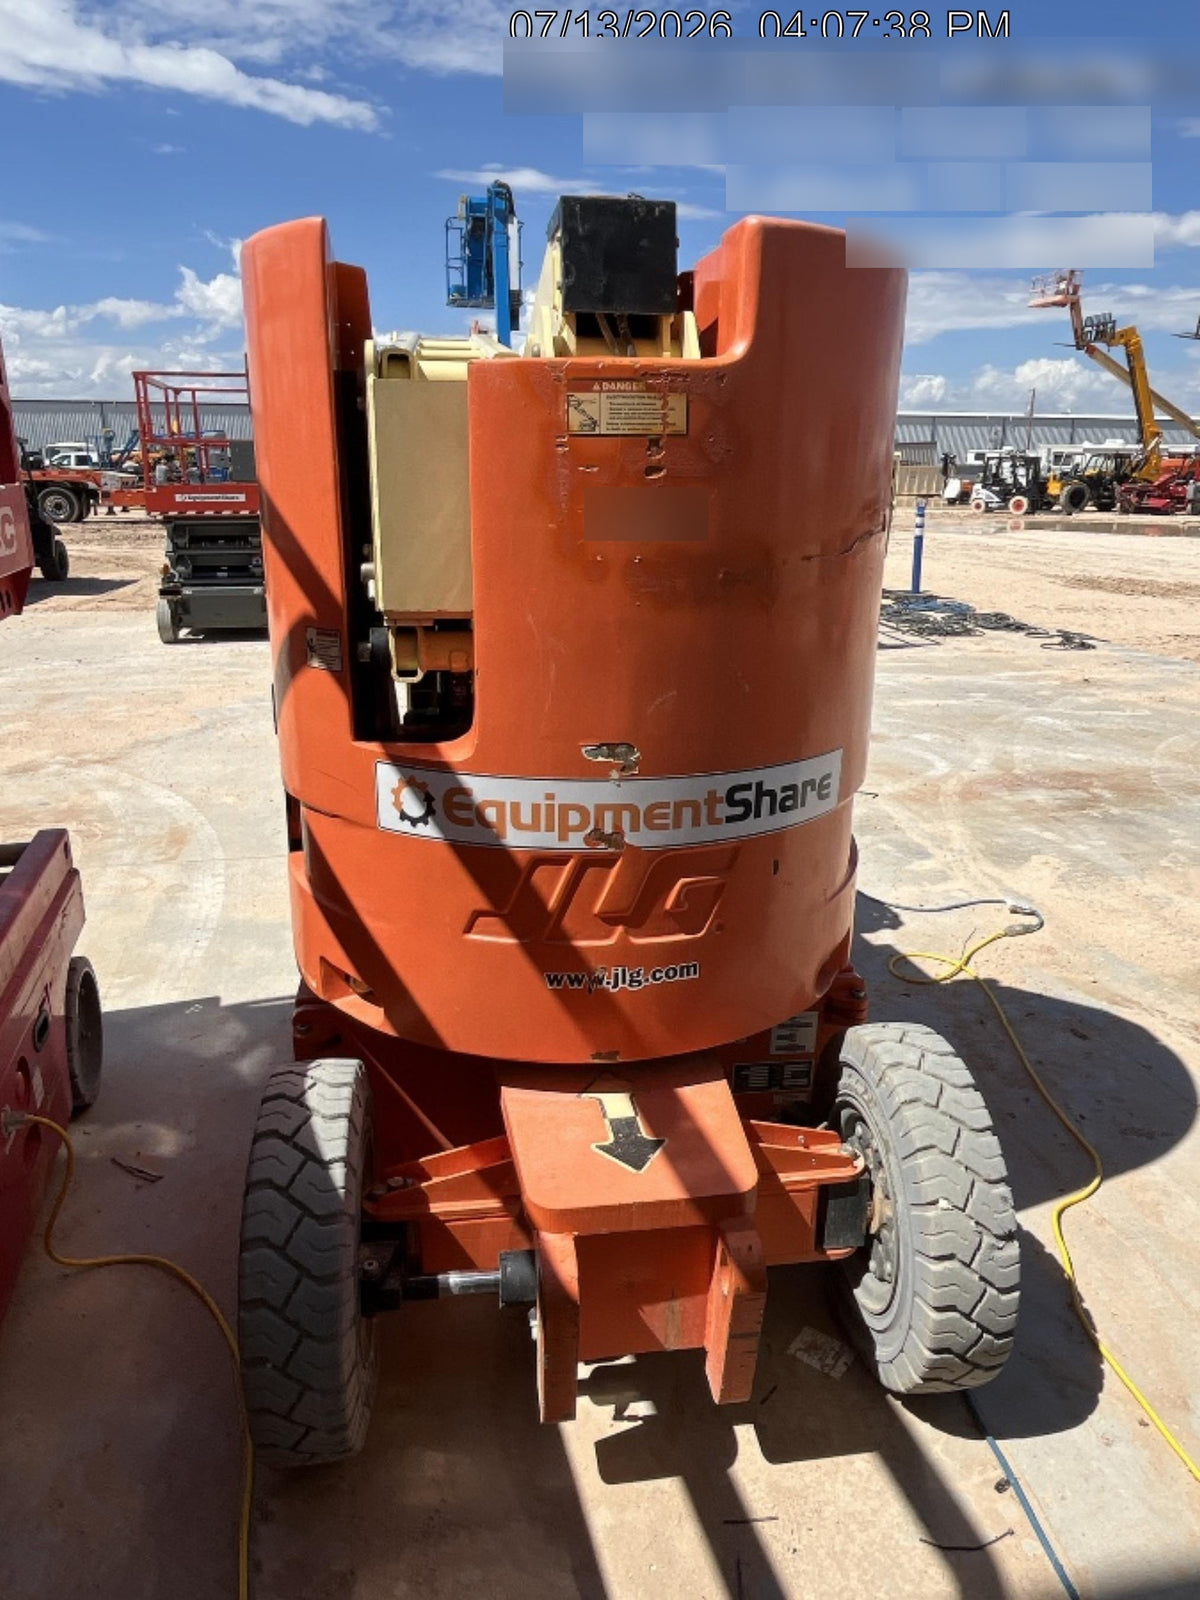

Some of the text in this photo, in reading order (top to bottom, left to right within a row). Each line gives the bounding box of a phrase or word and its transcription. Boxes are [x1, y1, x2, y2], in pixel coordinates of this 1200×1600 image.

[443, 772, 832, 842] EquipmentShare
[463, 850, 741, 947] JLG
[544, 961, 699, 992] www.jlg.com
